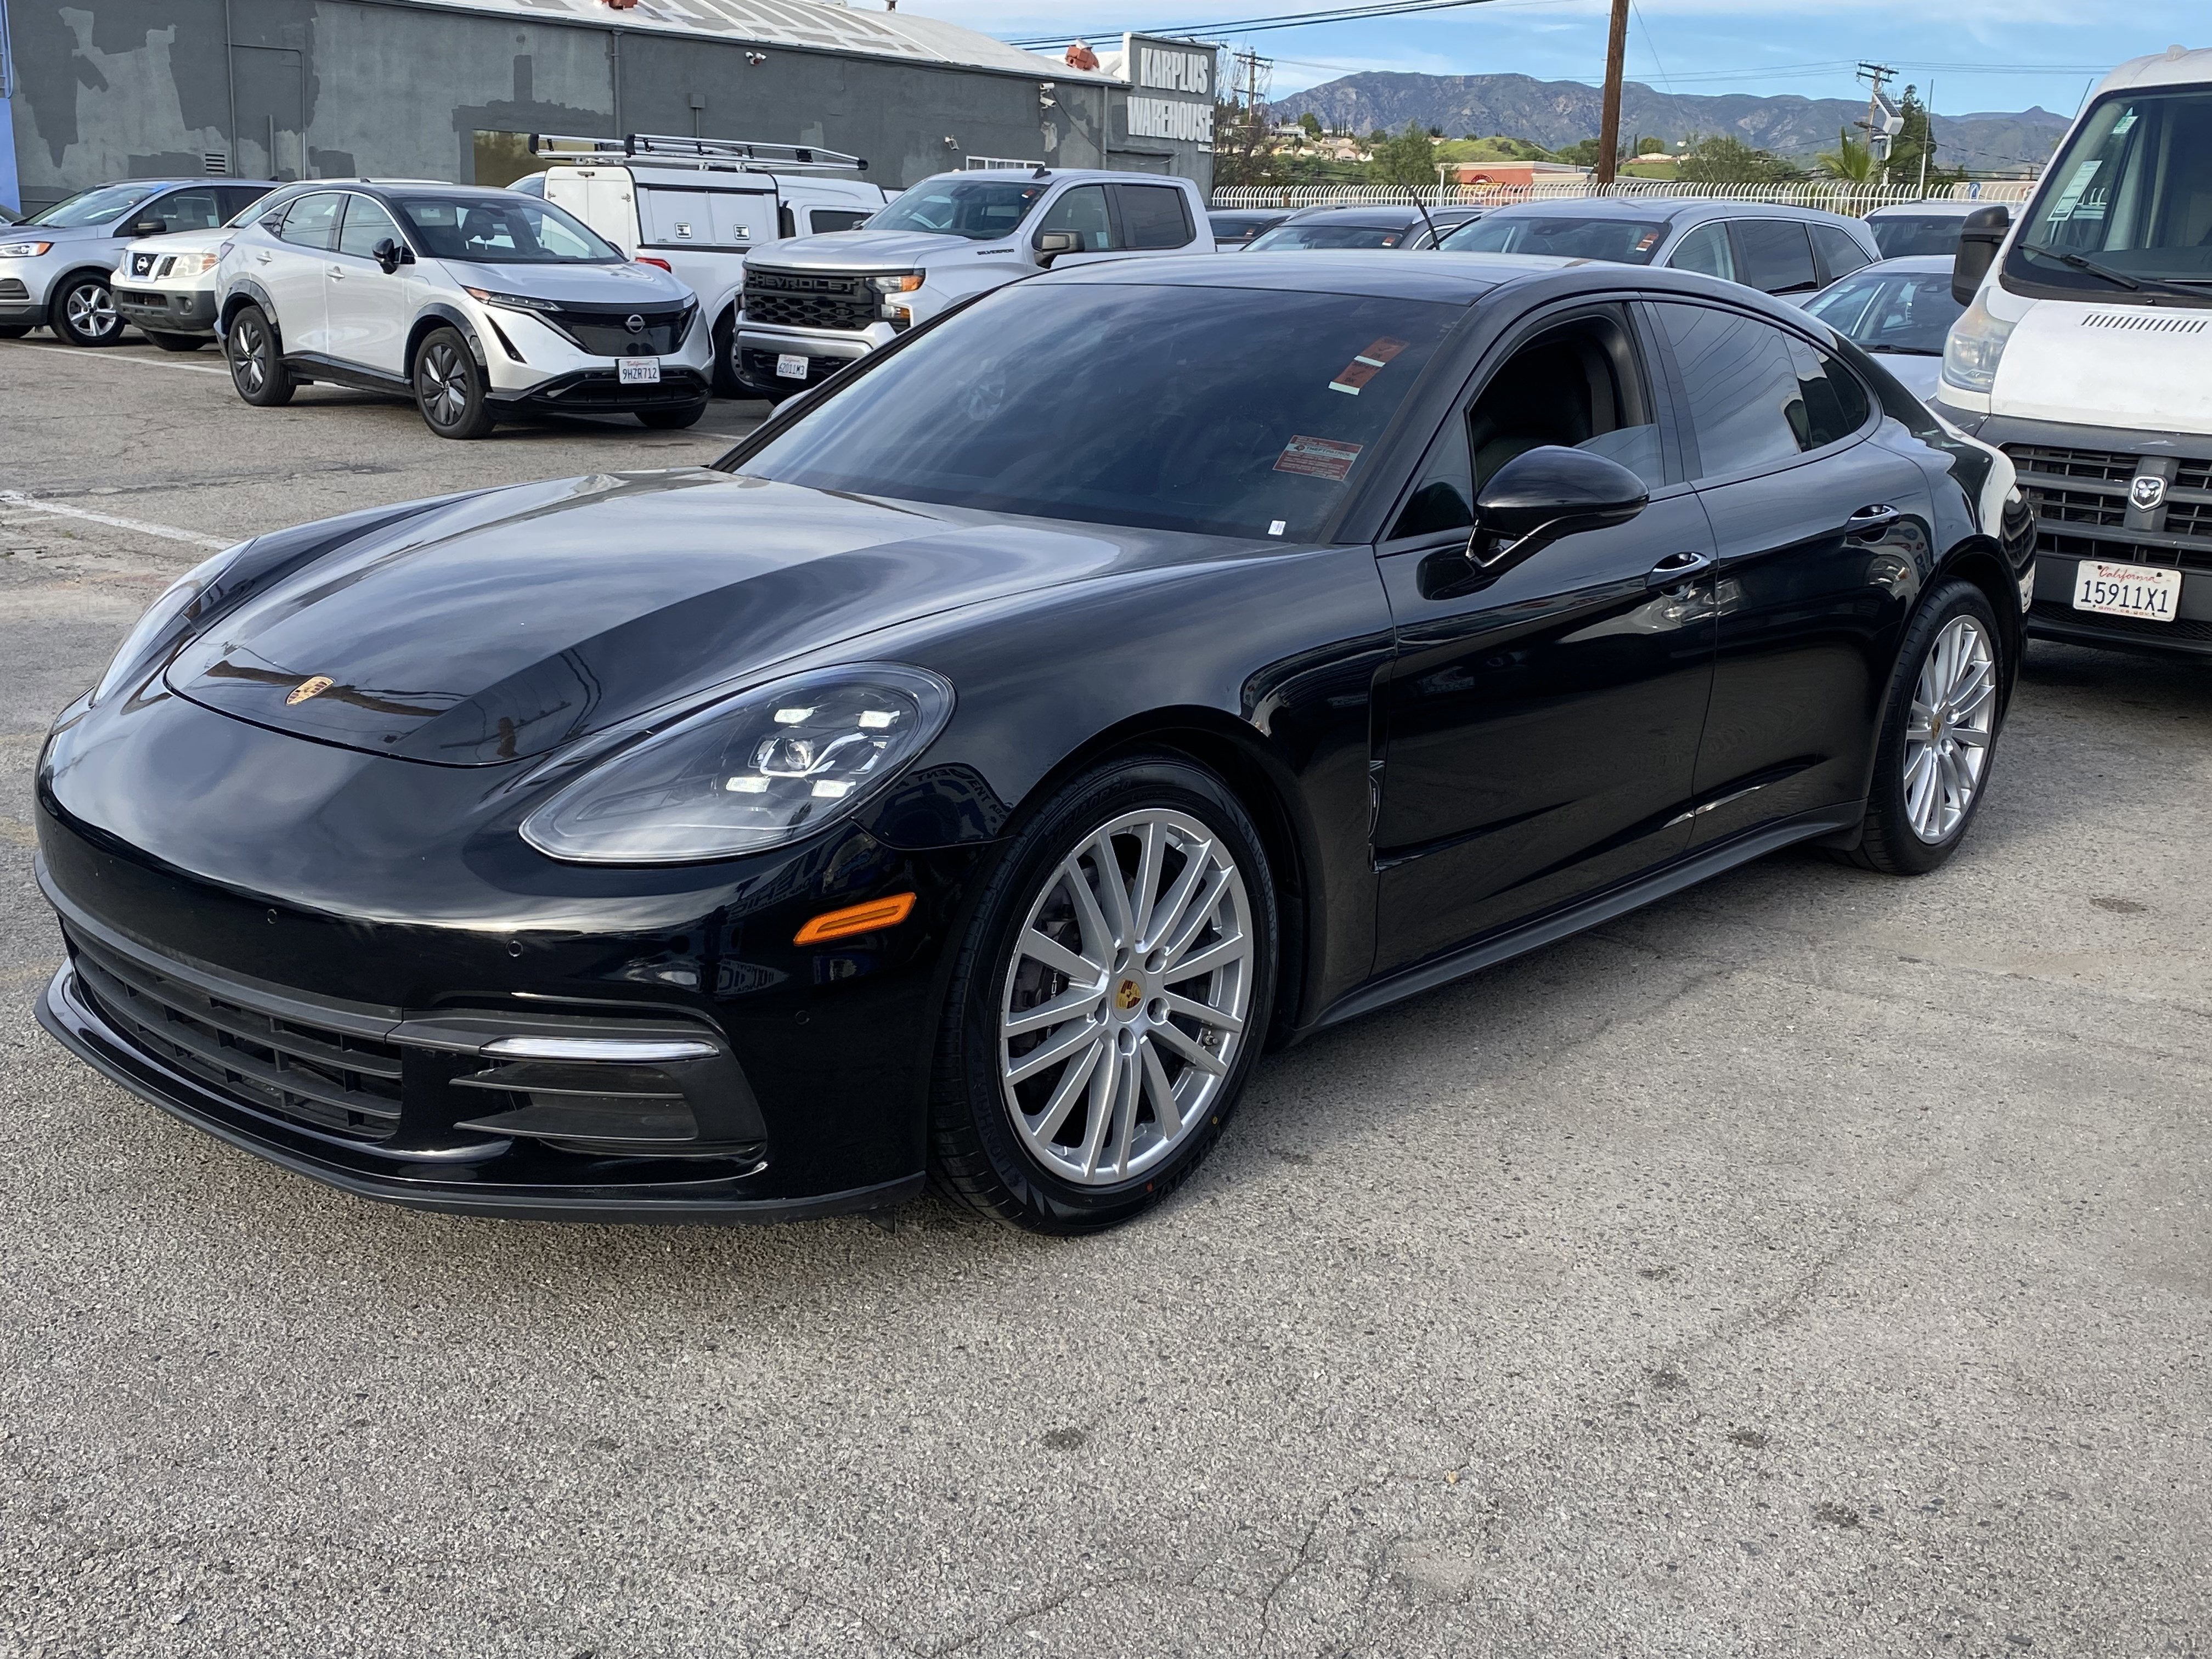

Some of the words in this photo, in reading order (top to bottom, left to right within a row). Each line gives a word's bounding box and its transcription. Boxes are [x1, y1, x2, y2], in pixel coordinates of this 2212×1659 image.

[1141, 47, 1208, 94] KARPLUS
[1127, 96, 1214, 143] WAREHOUSE
[748, 271, 857, 292] CHEVROLET
[623, 367, 657, 380] 9HZR712
[2100, 566, 2160, 584] California
[2081, 580, 2168, 613] 15911X1
